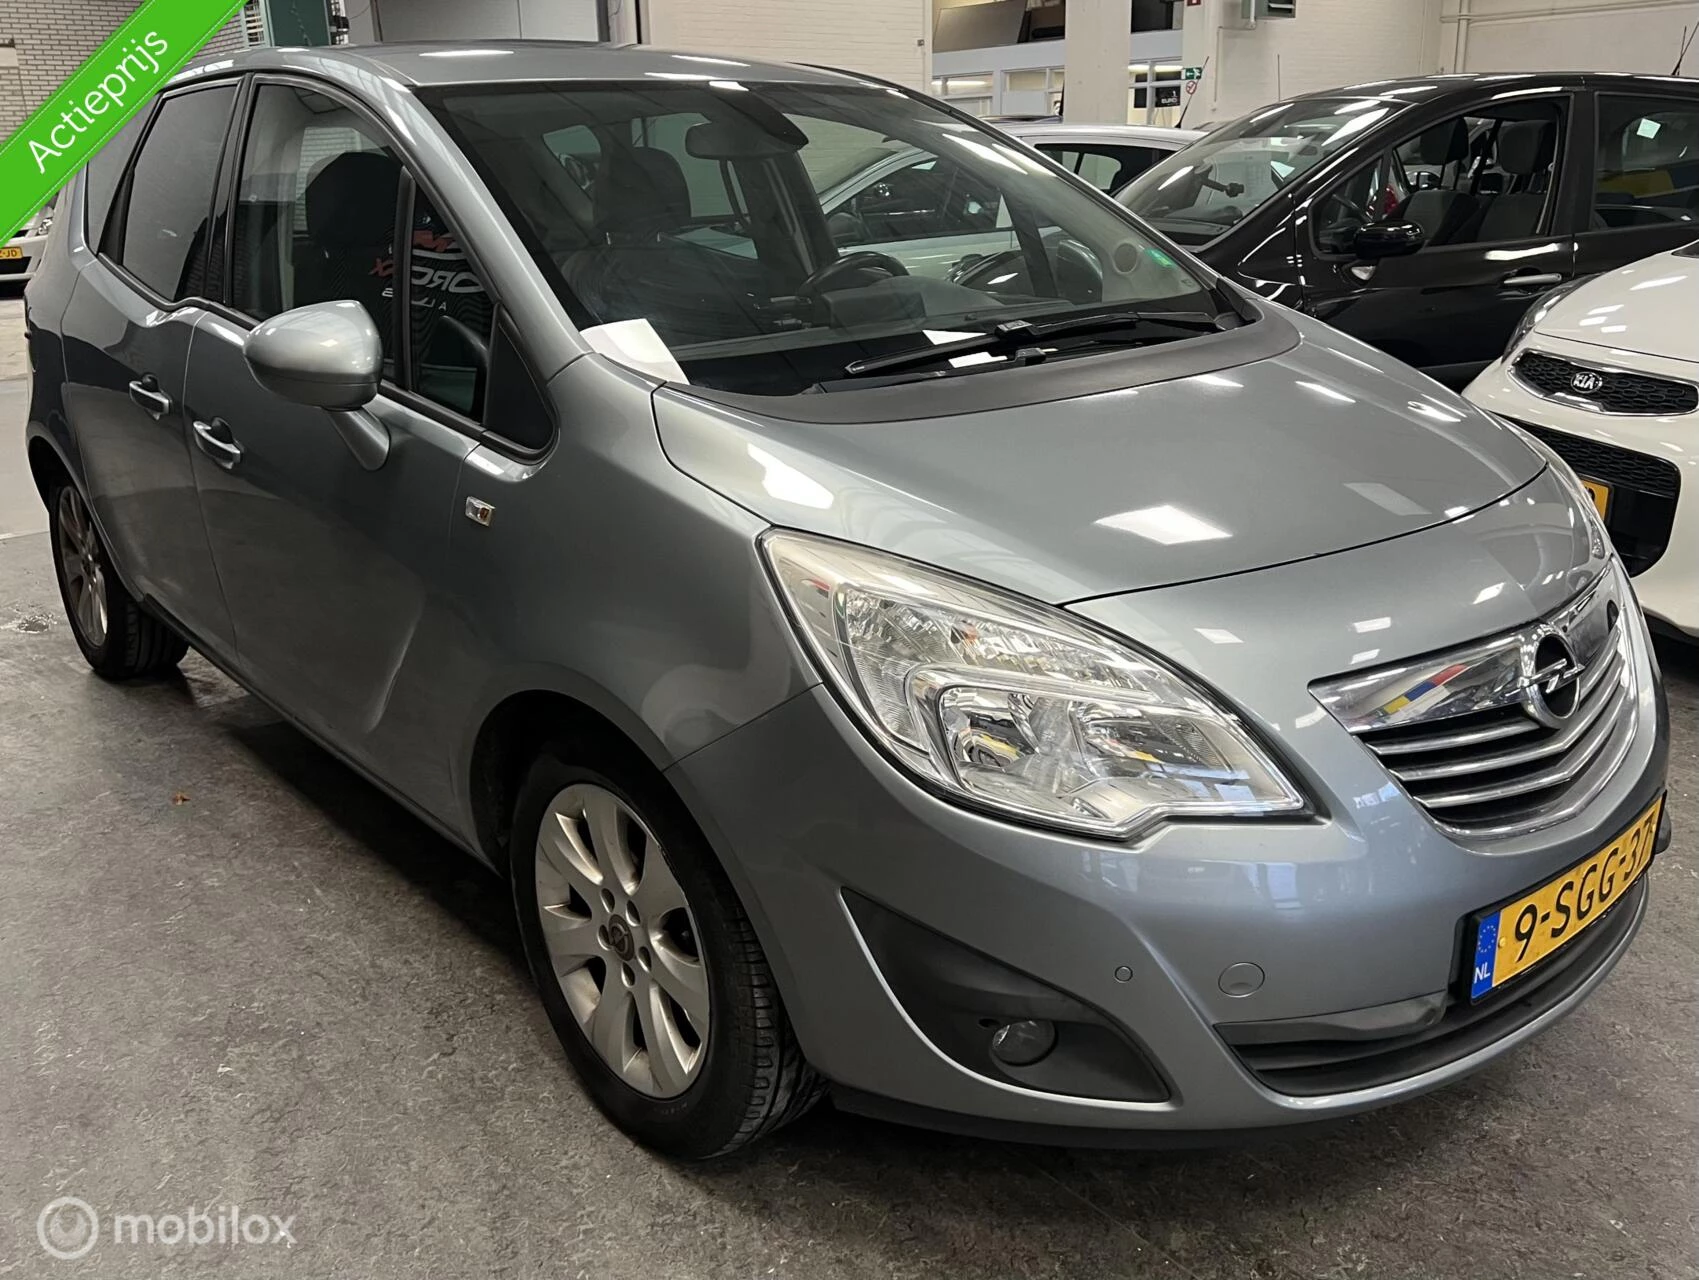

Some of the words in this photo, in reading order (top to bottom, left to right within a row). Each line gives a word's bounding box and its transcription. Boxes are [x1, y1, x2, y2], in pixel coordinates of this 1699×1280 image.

[1572, 373, 1596, 390] KIA
[1515, 811, 1656, 963] 9-SGG-37
[1473, 962, 1491, 984] NL
